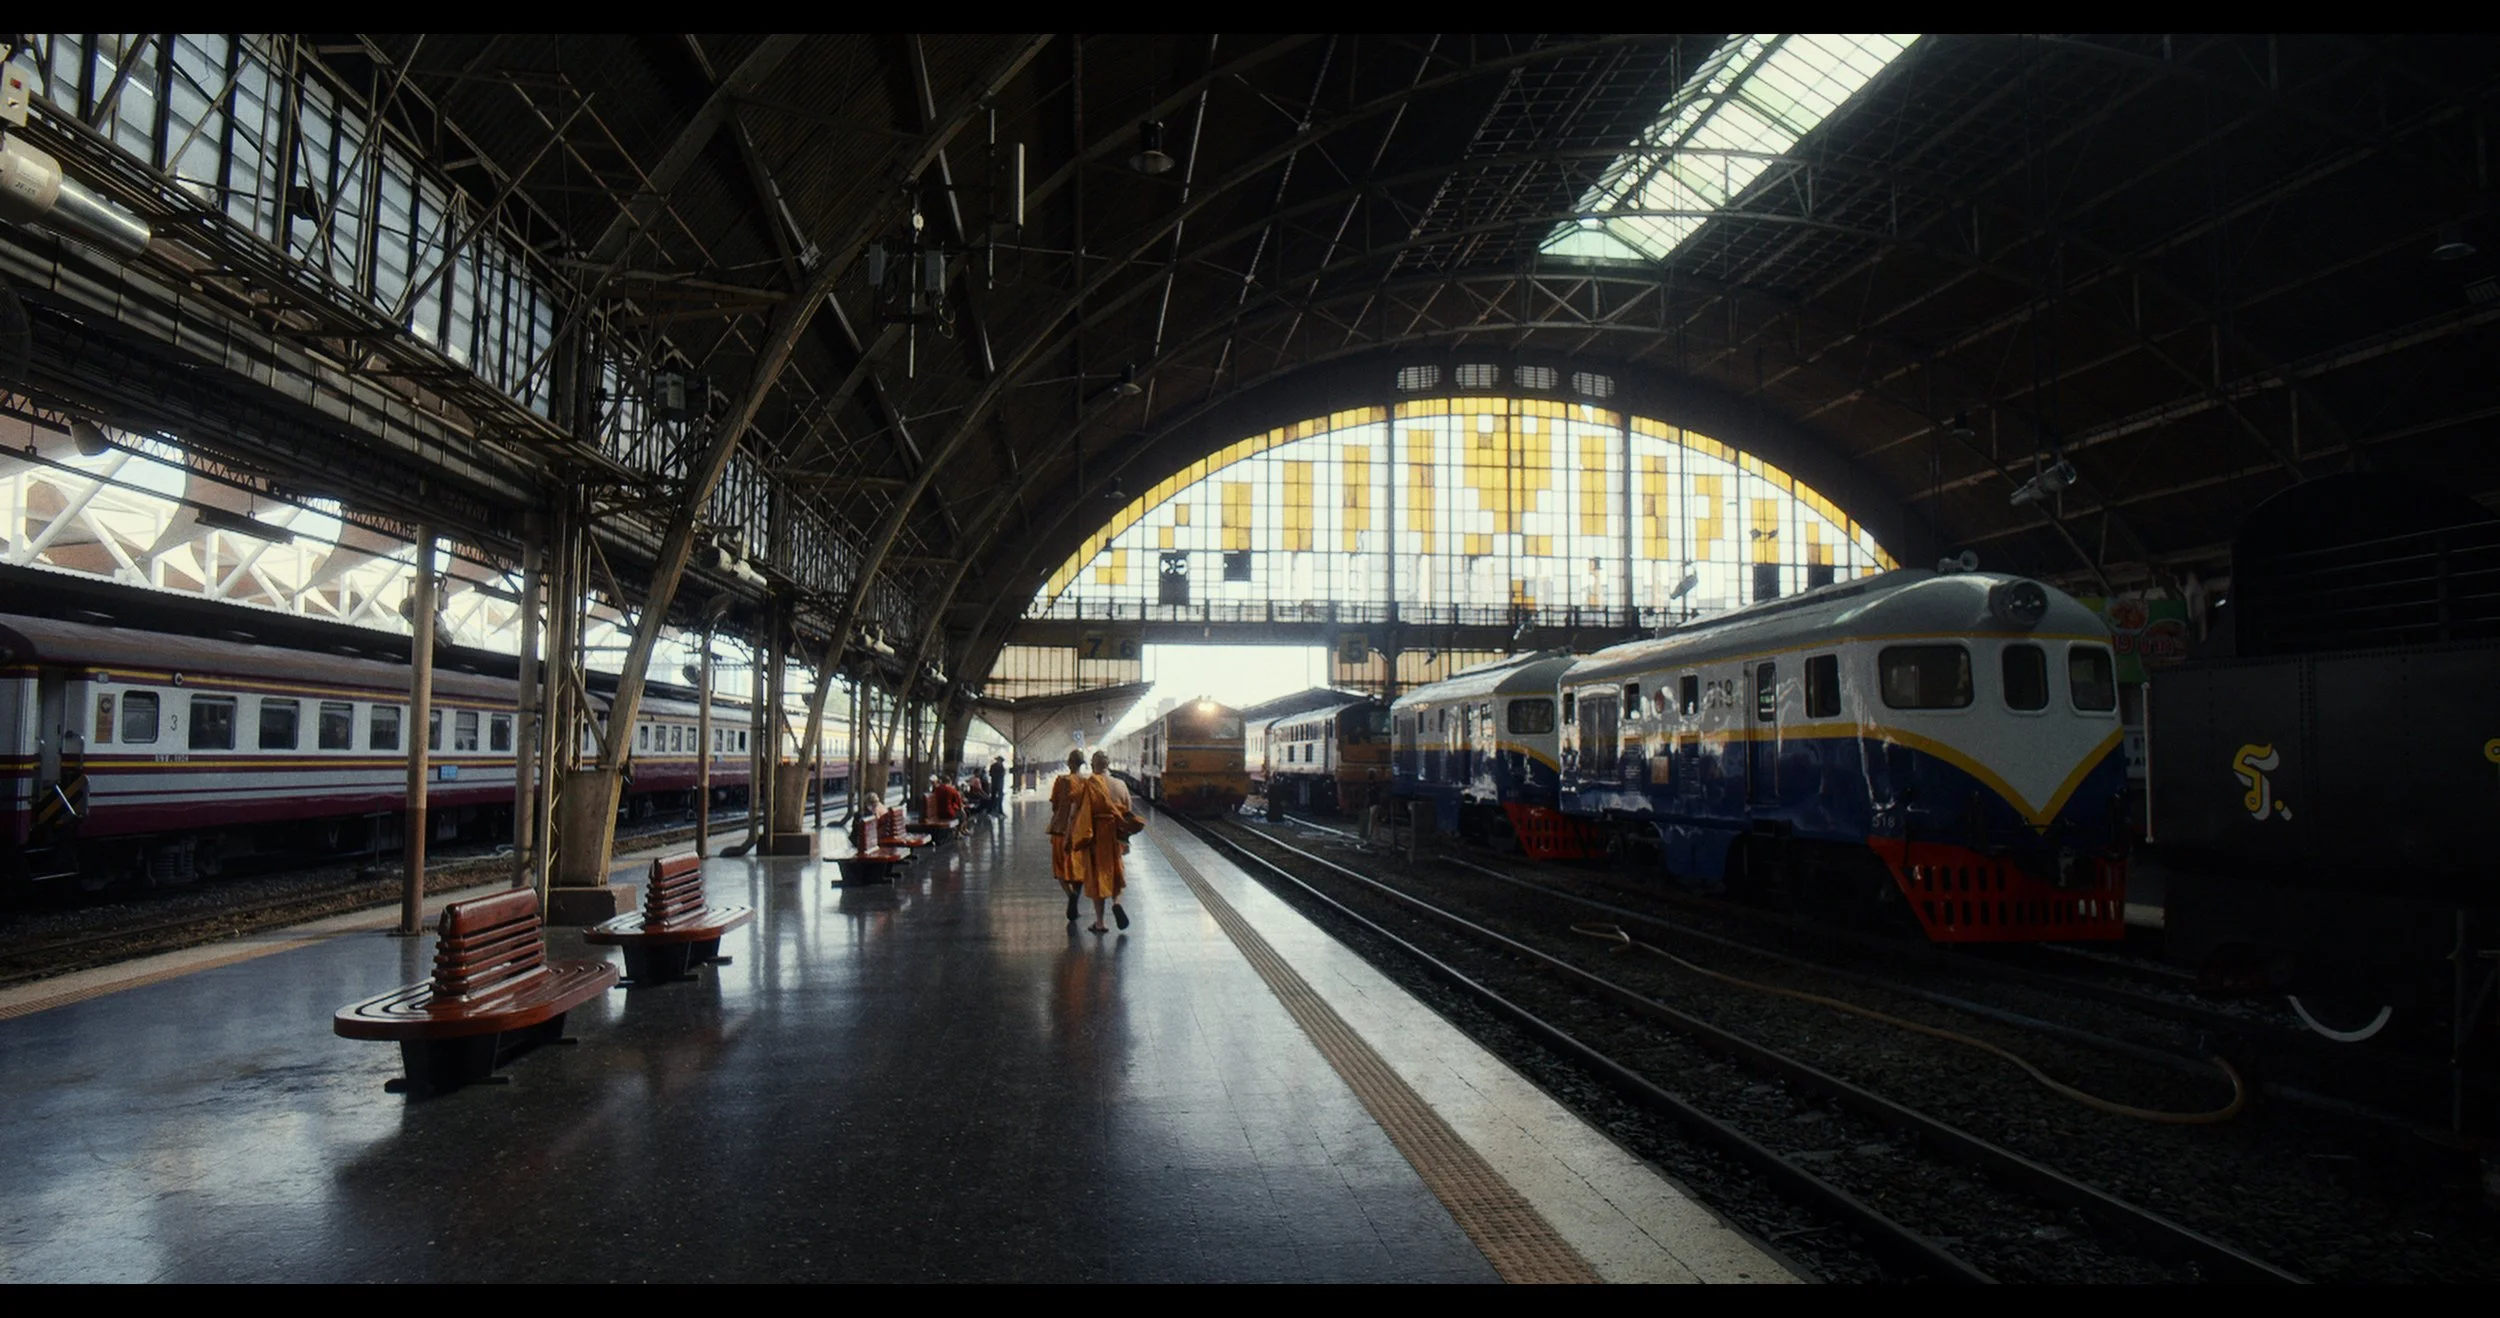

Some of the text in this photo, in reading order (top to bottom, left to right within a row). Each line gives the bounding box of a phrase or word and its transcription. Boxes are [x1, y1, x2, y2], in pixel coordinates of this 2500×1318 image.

[1087, 638, 1103, 658] 7
[1120, 638, 1135, 657] 6
[1346, 640, 1362, 660] 5
[170, 714, 178, 730] 3
[2232, 743, 2292, 821] ร.
[1871, 812, 1896, 829] 518
